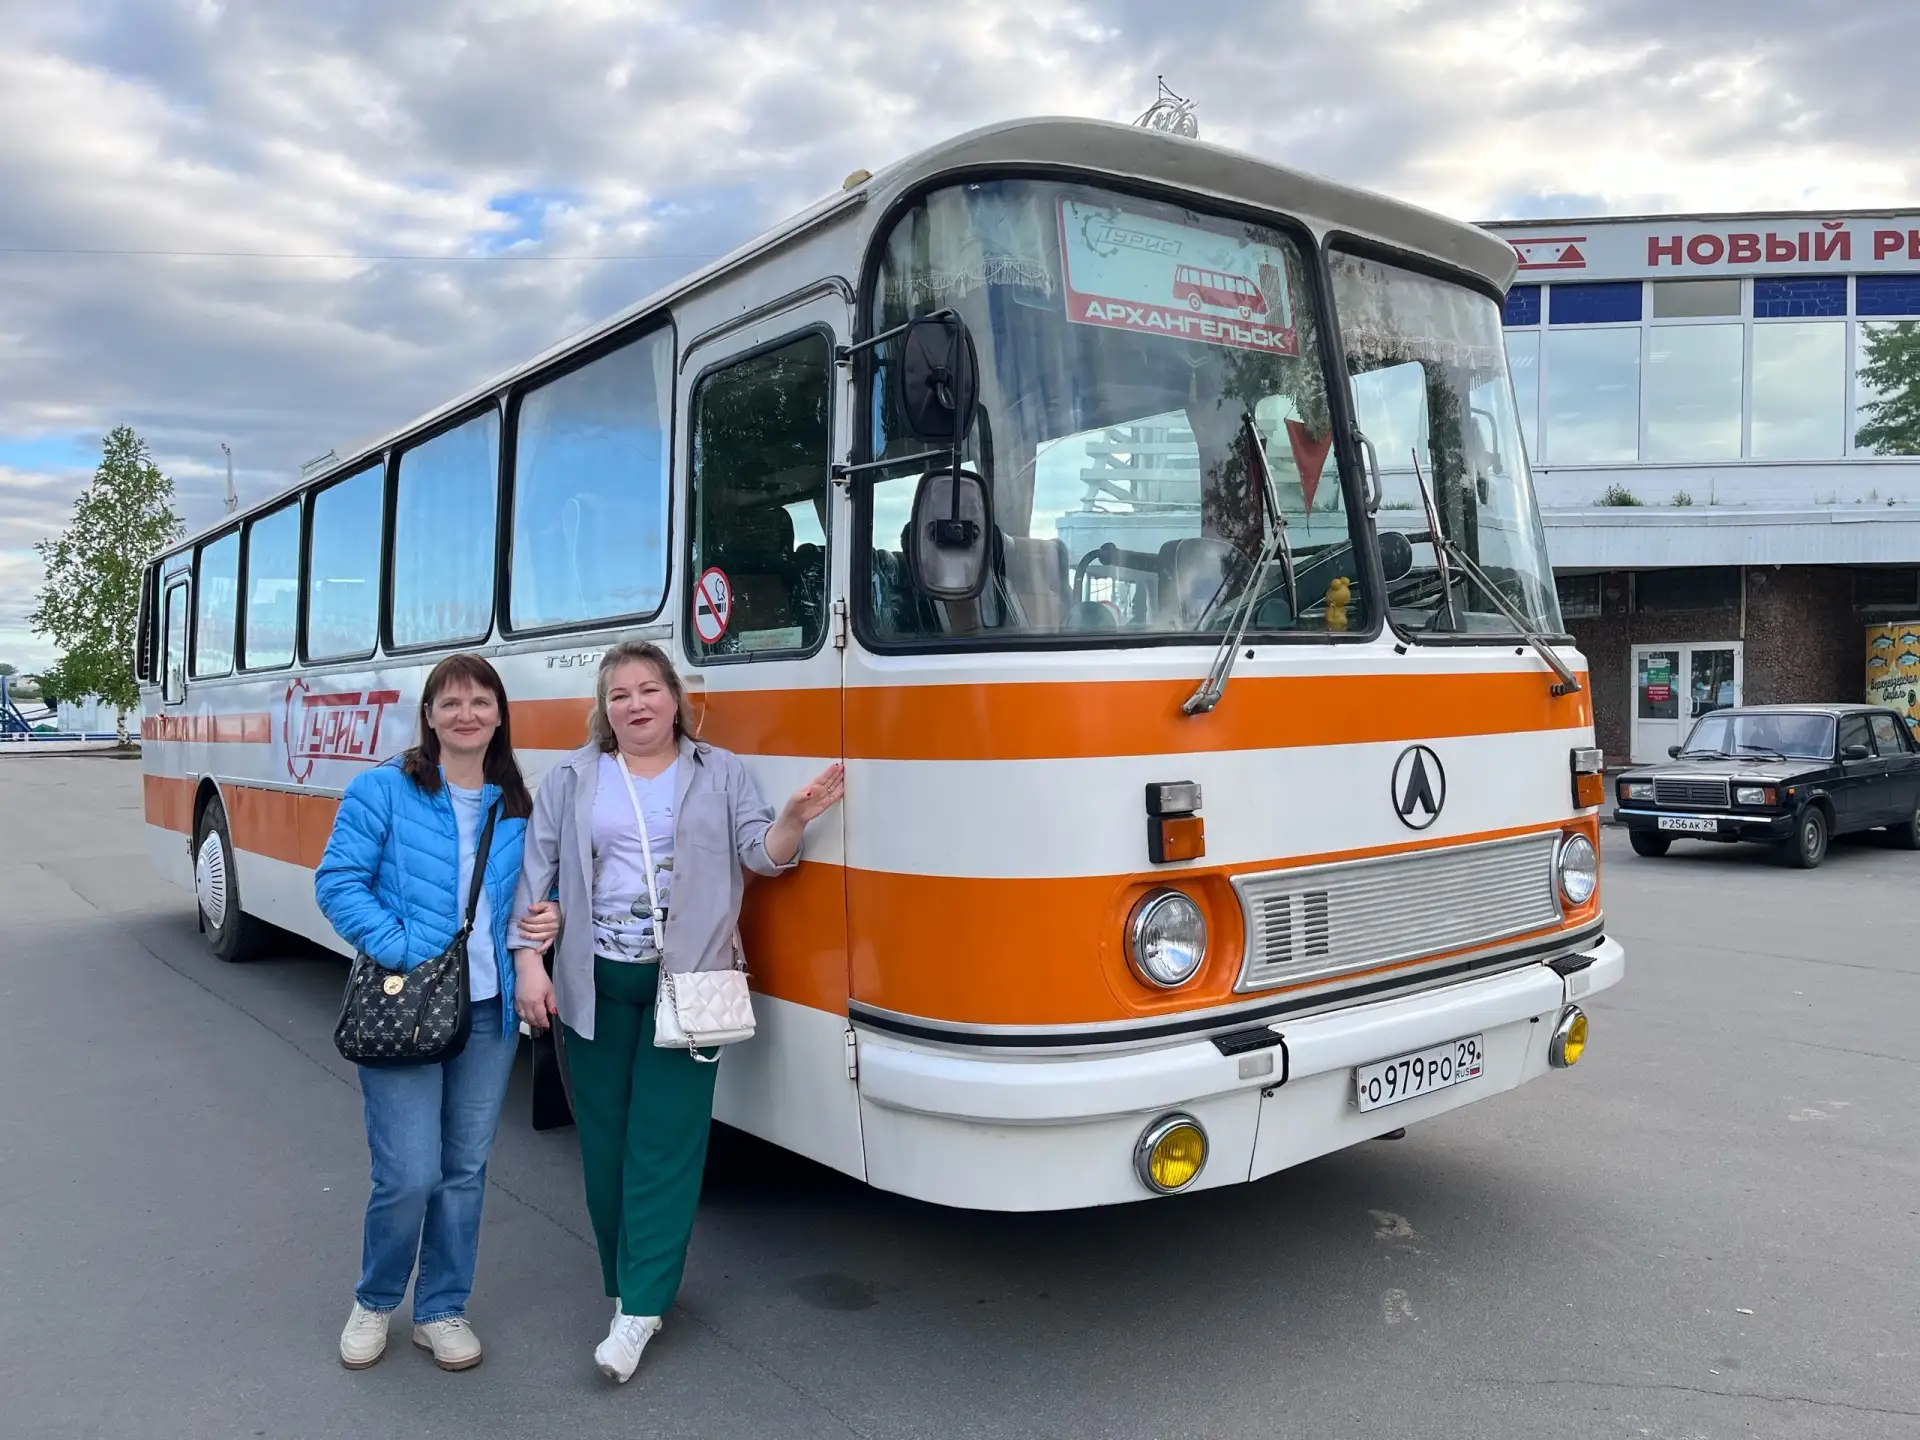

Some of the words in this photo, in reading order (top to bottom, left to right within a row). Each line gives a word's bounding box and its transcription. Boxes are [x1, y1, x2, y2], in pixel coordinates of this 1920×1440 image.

[1100, 225, 1183, 255] ТУРИСТ
[1648, 222, 1851, 266] НОВЫЙ
[1873, 229, 1920, 260] Р
[1085, 301, 1285, 349] АРХАНГЕЛЬСК
[299, 690, 401, 755] ТУРИСТ
[1457, 1040, 1476, 1068] 29
[1456, 1067, 1470, 1079] RUS
